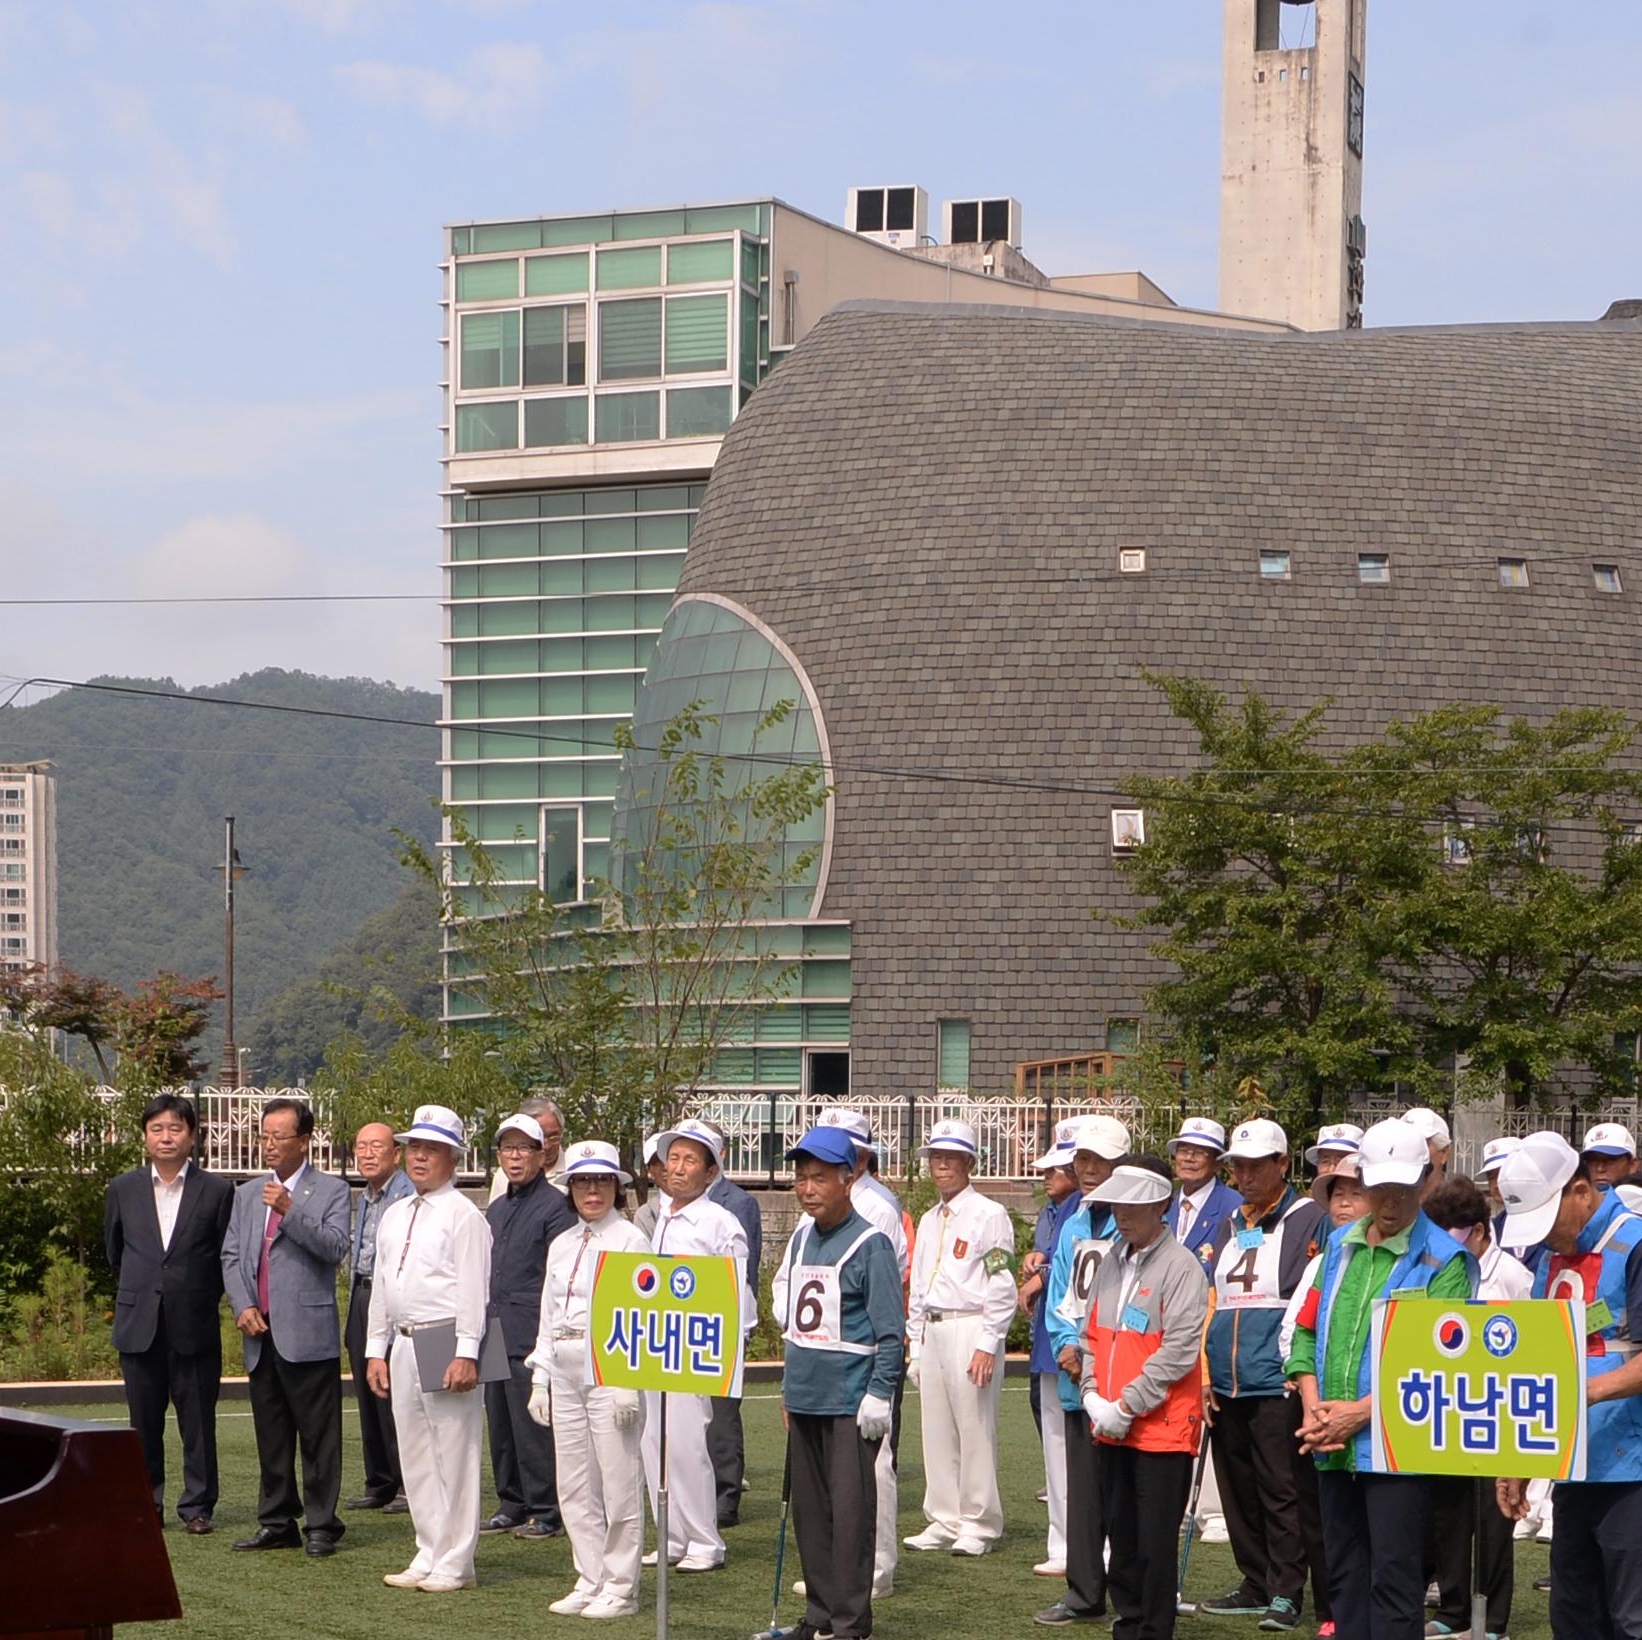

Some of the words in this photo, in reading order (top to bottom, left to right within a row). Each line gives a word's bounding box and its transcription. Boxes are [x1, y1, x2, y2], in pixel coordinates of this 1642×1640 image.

[1225, 1249, 1259, 1293] 4
[795, 1279, 826, 1333] 6
[605, 1307, 724, 1375] 사내면
[1398, 1367, 1560, 1455] 하남면
